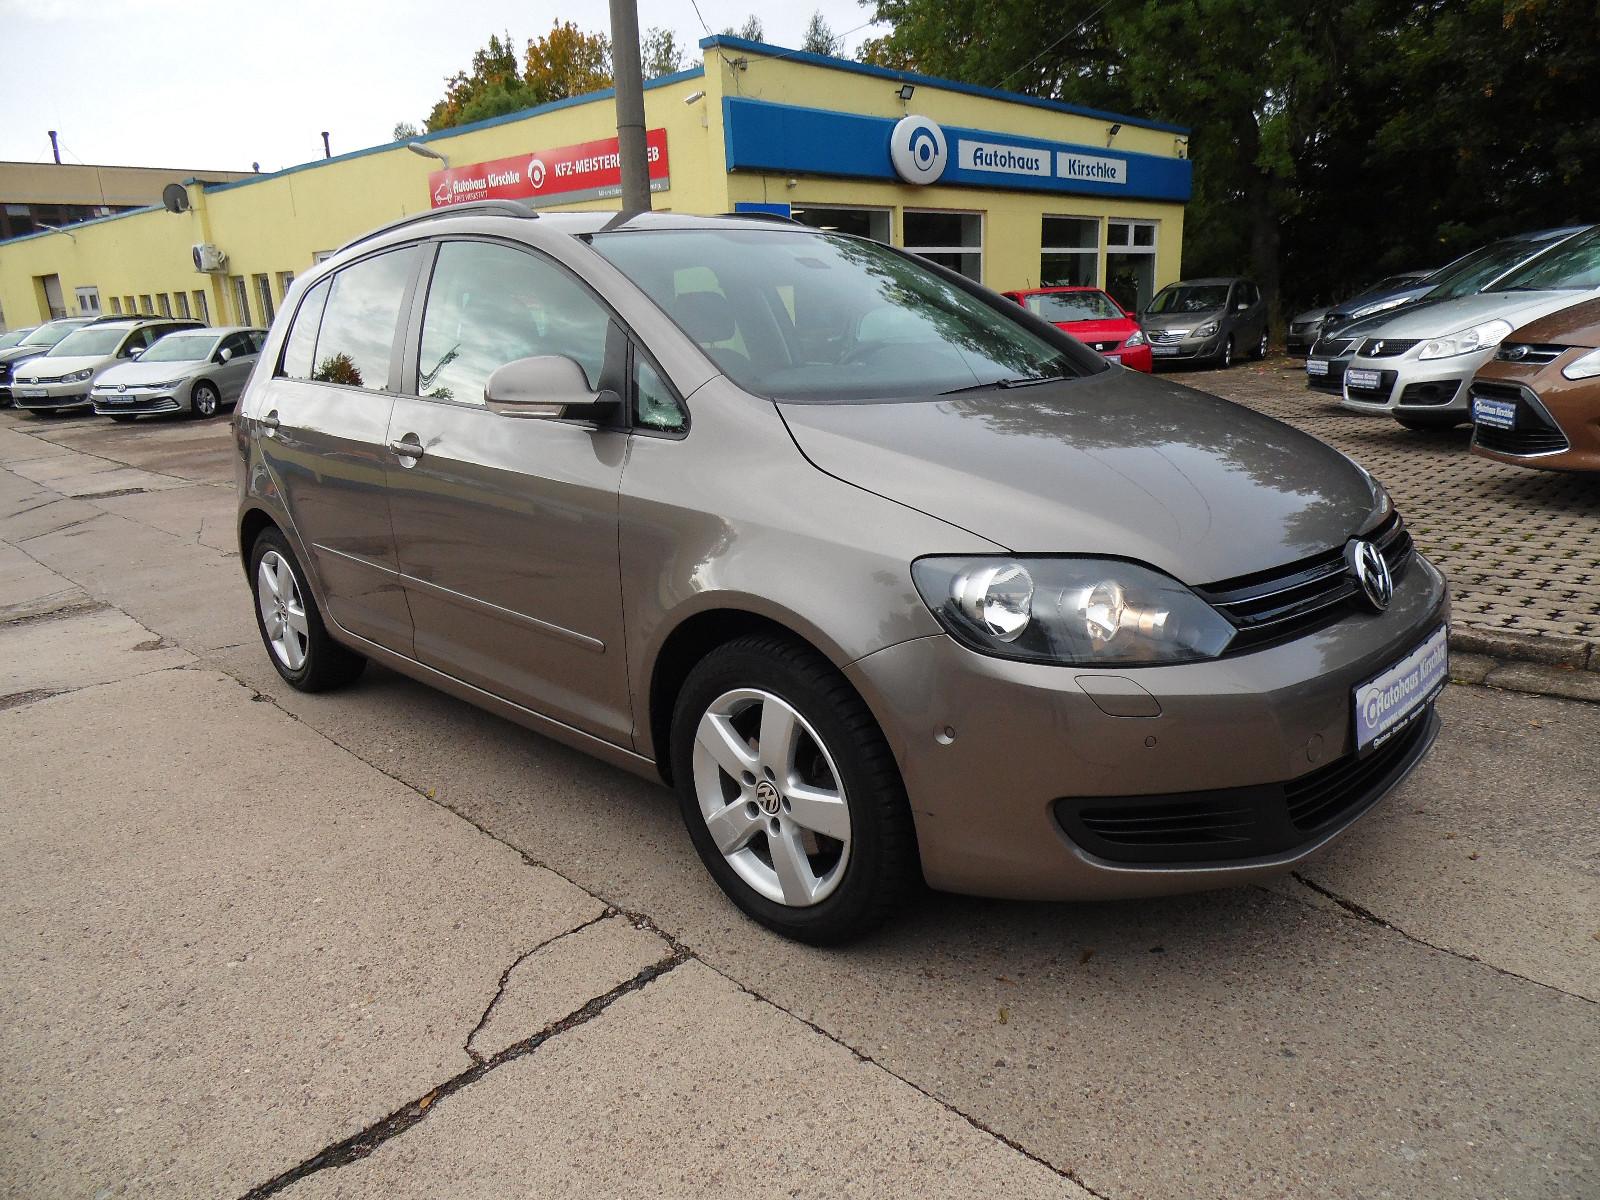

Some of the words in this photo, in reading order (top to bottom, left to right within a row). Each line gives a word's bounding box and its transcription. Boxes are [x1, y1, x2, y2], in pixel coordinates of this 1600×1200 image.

[973, 147, 1039, 171] Autohaus
[1068, 159, 1116, 179] Kirschke
[453, 178, 487, 194] Autohaus
[488, 171, 520, 188] Kirschke
[1377, 672, 1418, 715] Autohaus
[1420, 644, 1445, 680] Kirschke
